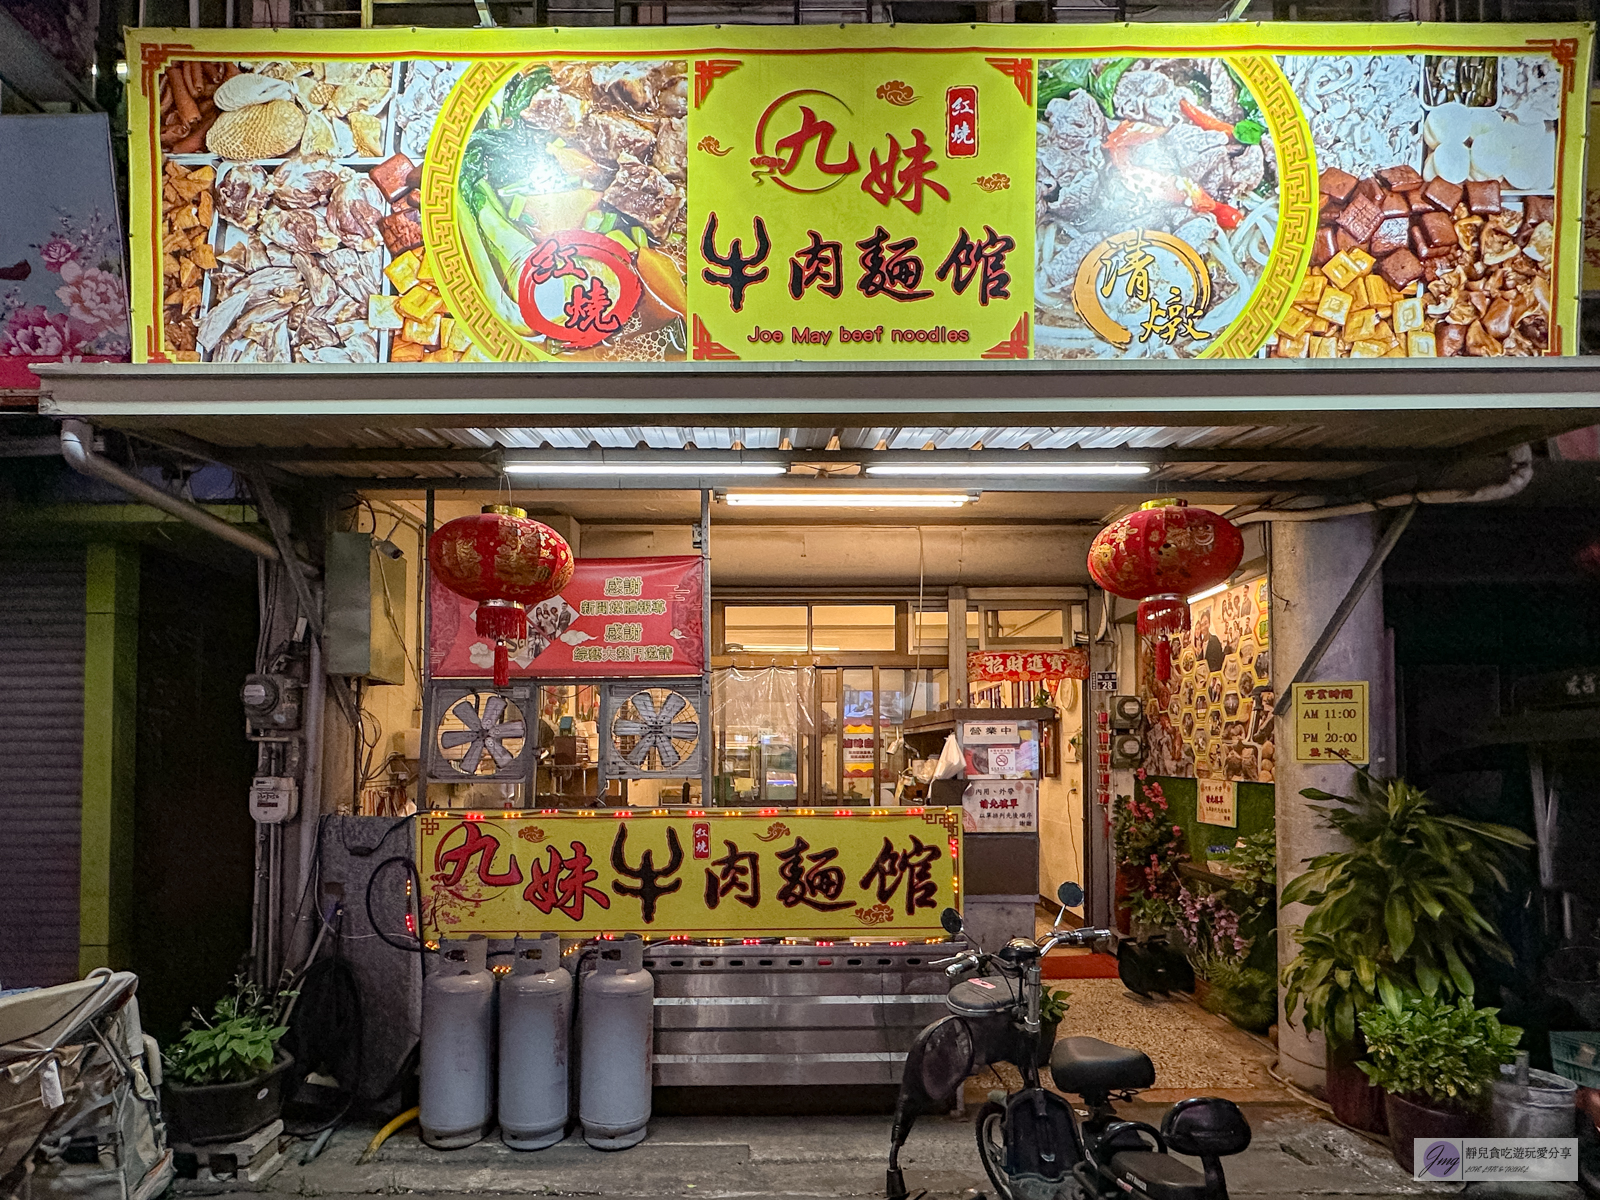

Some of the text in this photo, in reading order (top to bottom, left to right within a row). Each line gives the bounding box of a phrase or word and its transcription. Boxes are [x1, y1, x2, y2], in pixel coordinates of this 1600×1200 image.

[776, 105, 951, 215] 九妹
[700, 211, 1017, 313] 牛肉麵館
[747, 325, 970, 345] Joe May beef noodles
[603, 576, 643, 596] 感謝
[603, 622, 643, 642] 感謝
[983, 654, 1066, 674] 招財進寶
[1303, 709, 1356, 719] AM 11:00
[970, 726, 1012, 736] 營業中
[1303, 733, 1357, 743] PM 20:00
[440, 821, 940, 923] 九妹牛肉麵館
